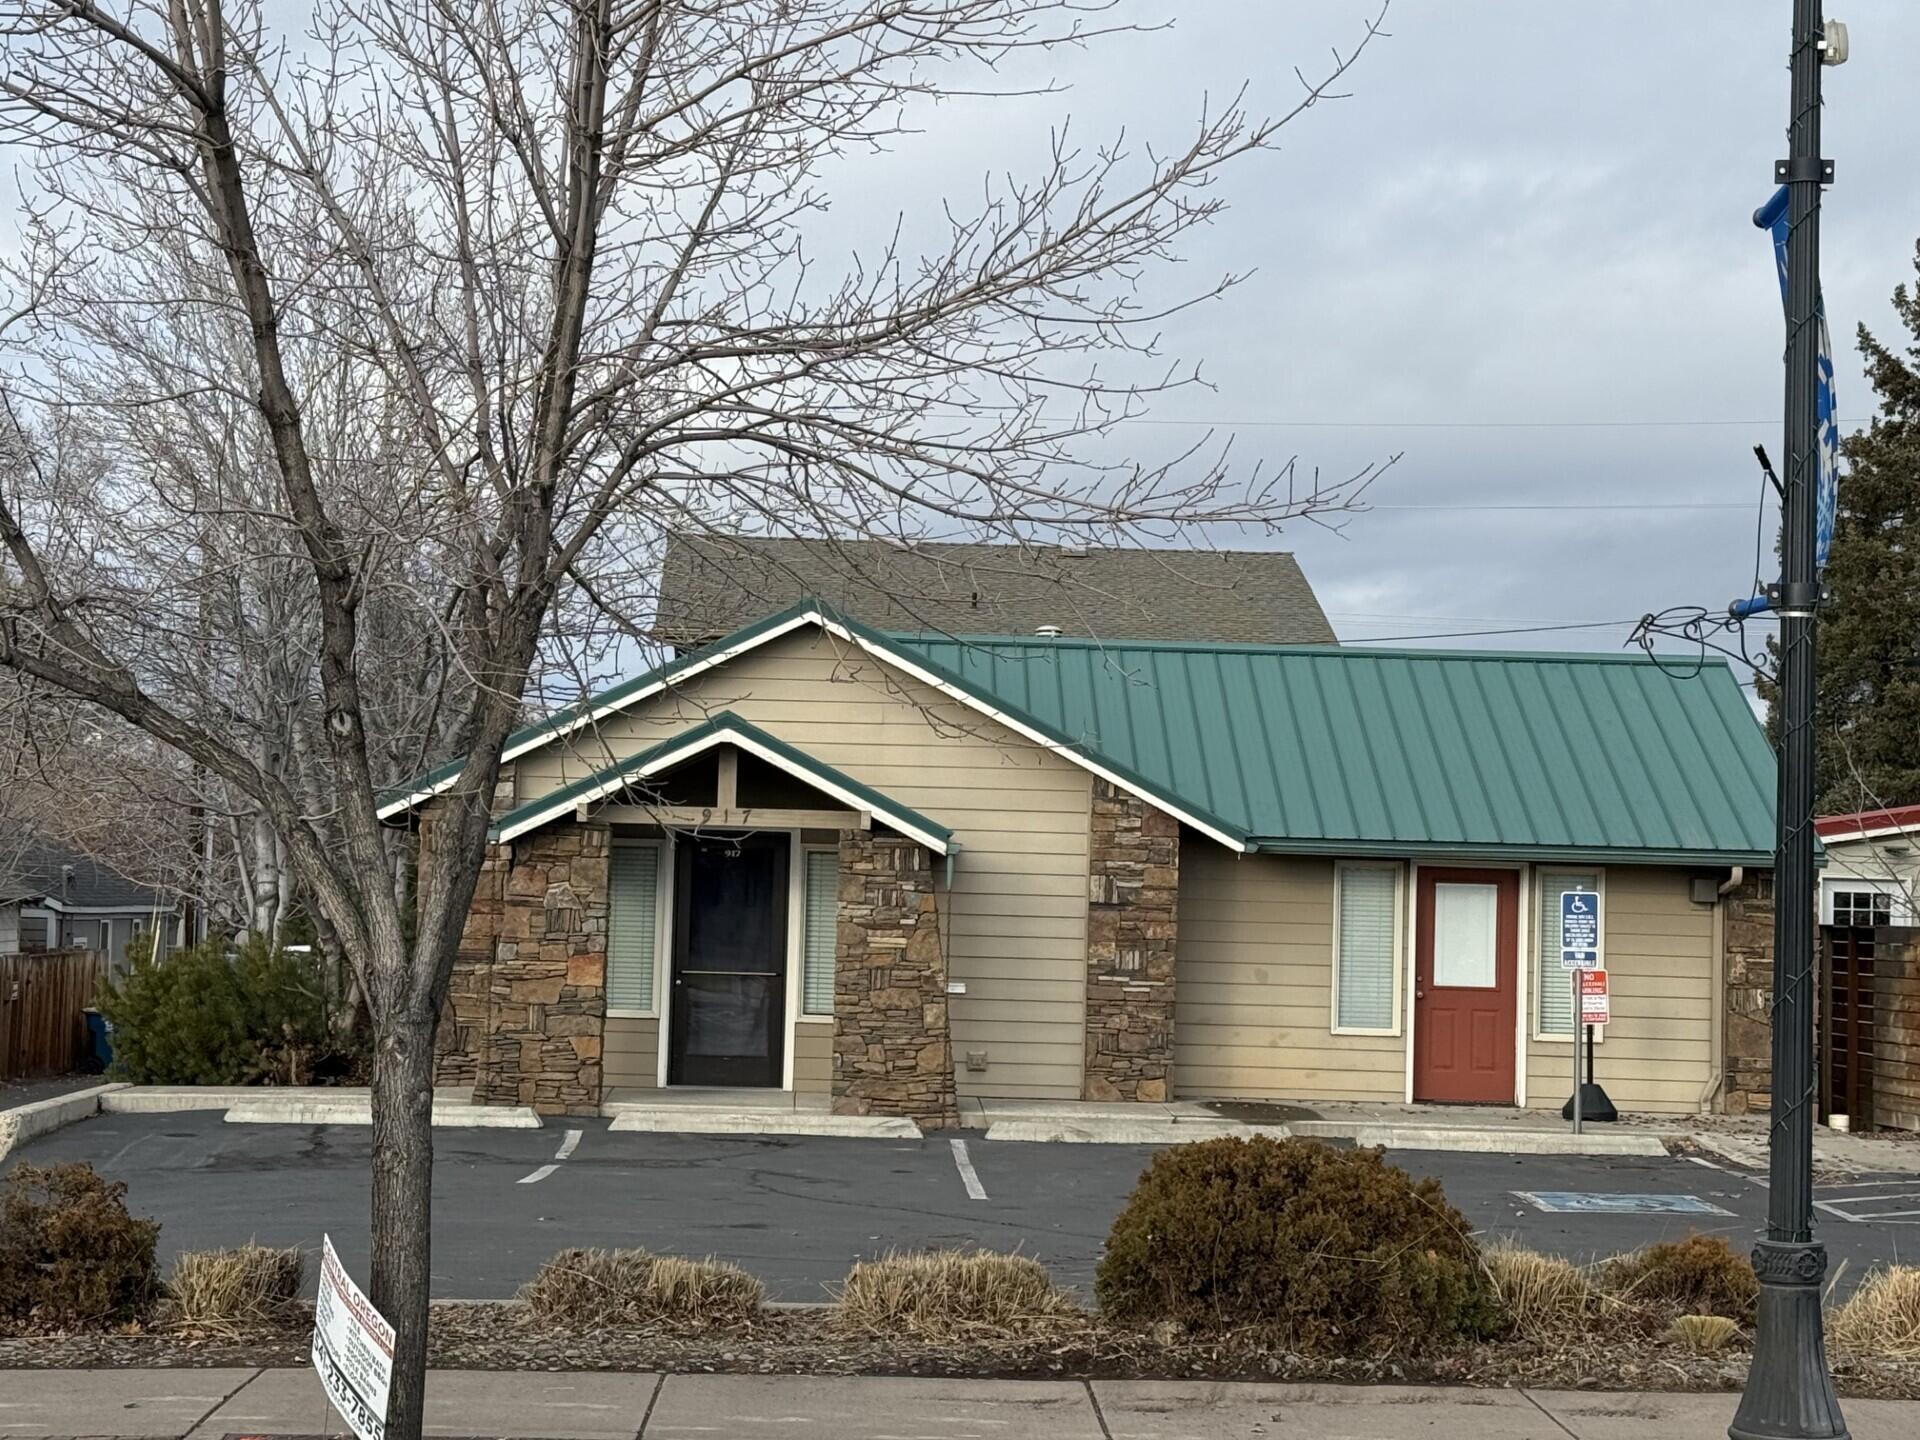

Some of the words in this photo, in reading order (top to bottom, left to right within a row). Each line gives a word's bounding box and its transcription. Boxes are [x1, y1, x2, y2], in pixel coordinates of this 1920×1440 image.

[702, 808, 752, 826] 917
[724, 849, 741, 858] 917
[352, 1289, 392, 1347] OREGON
[314, 1333, 381, 1440] 541-233-7855
